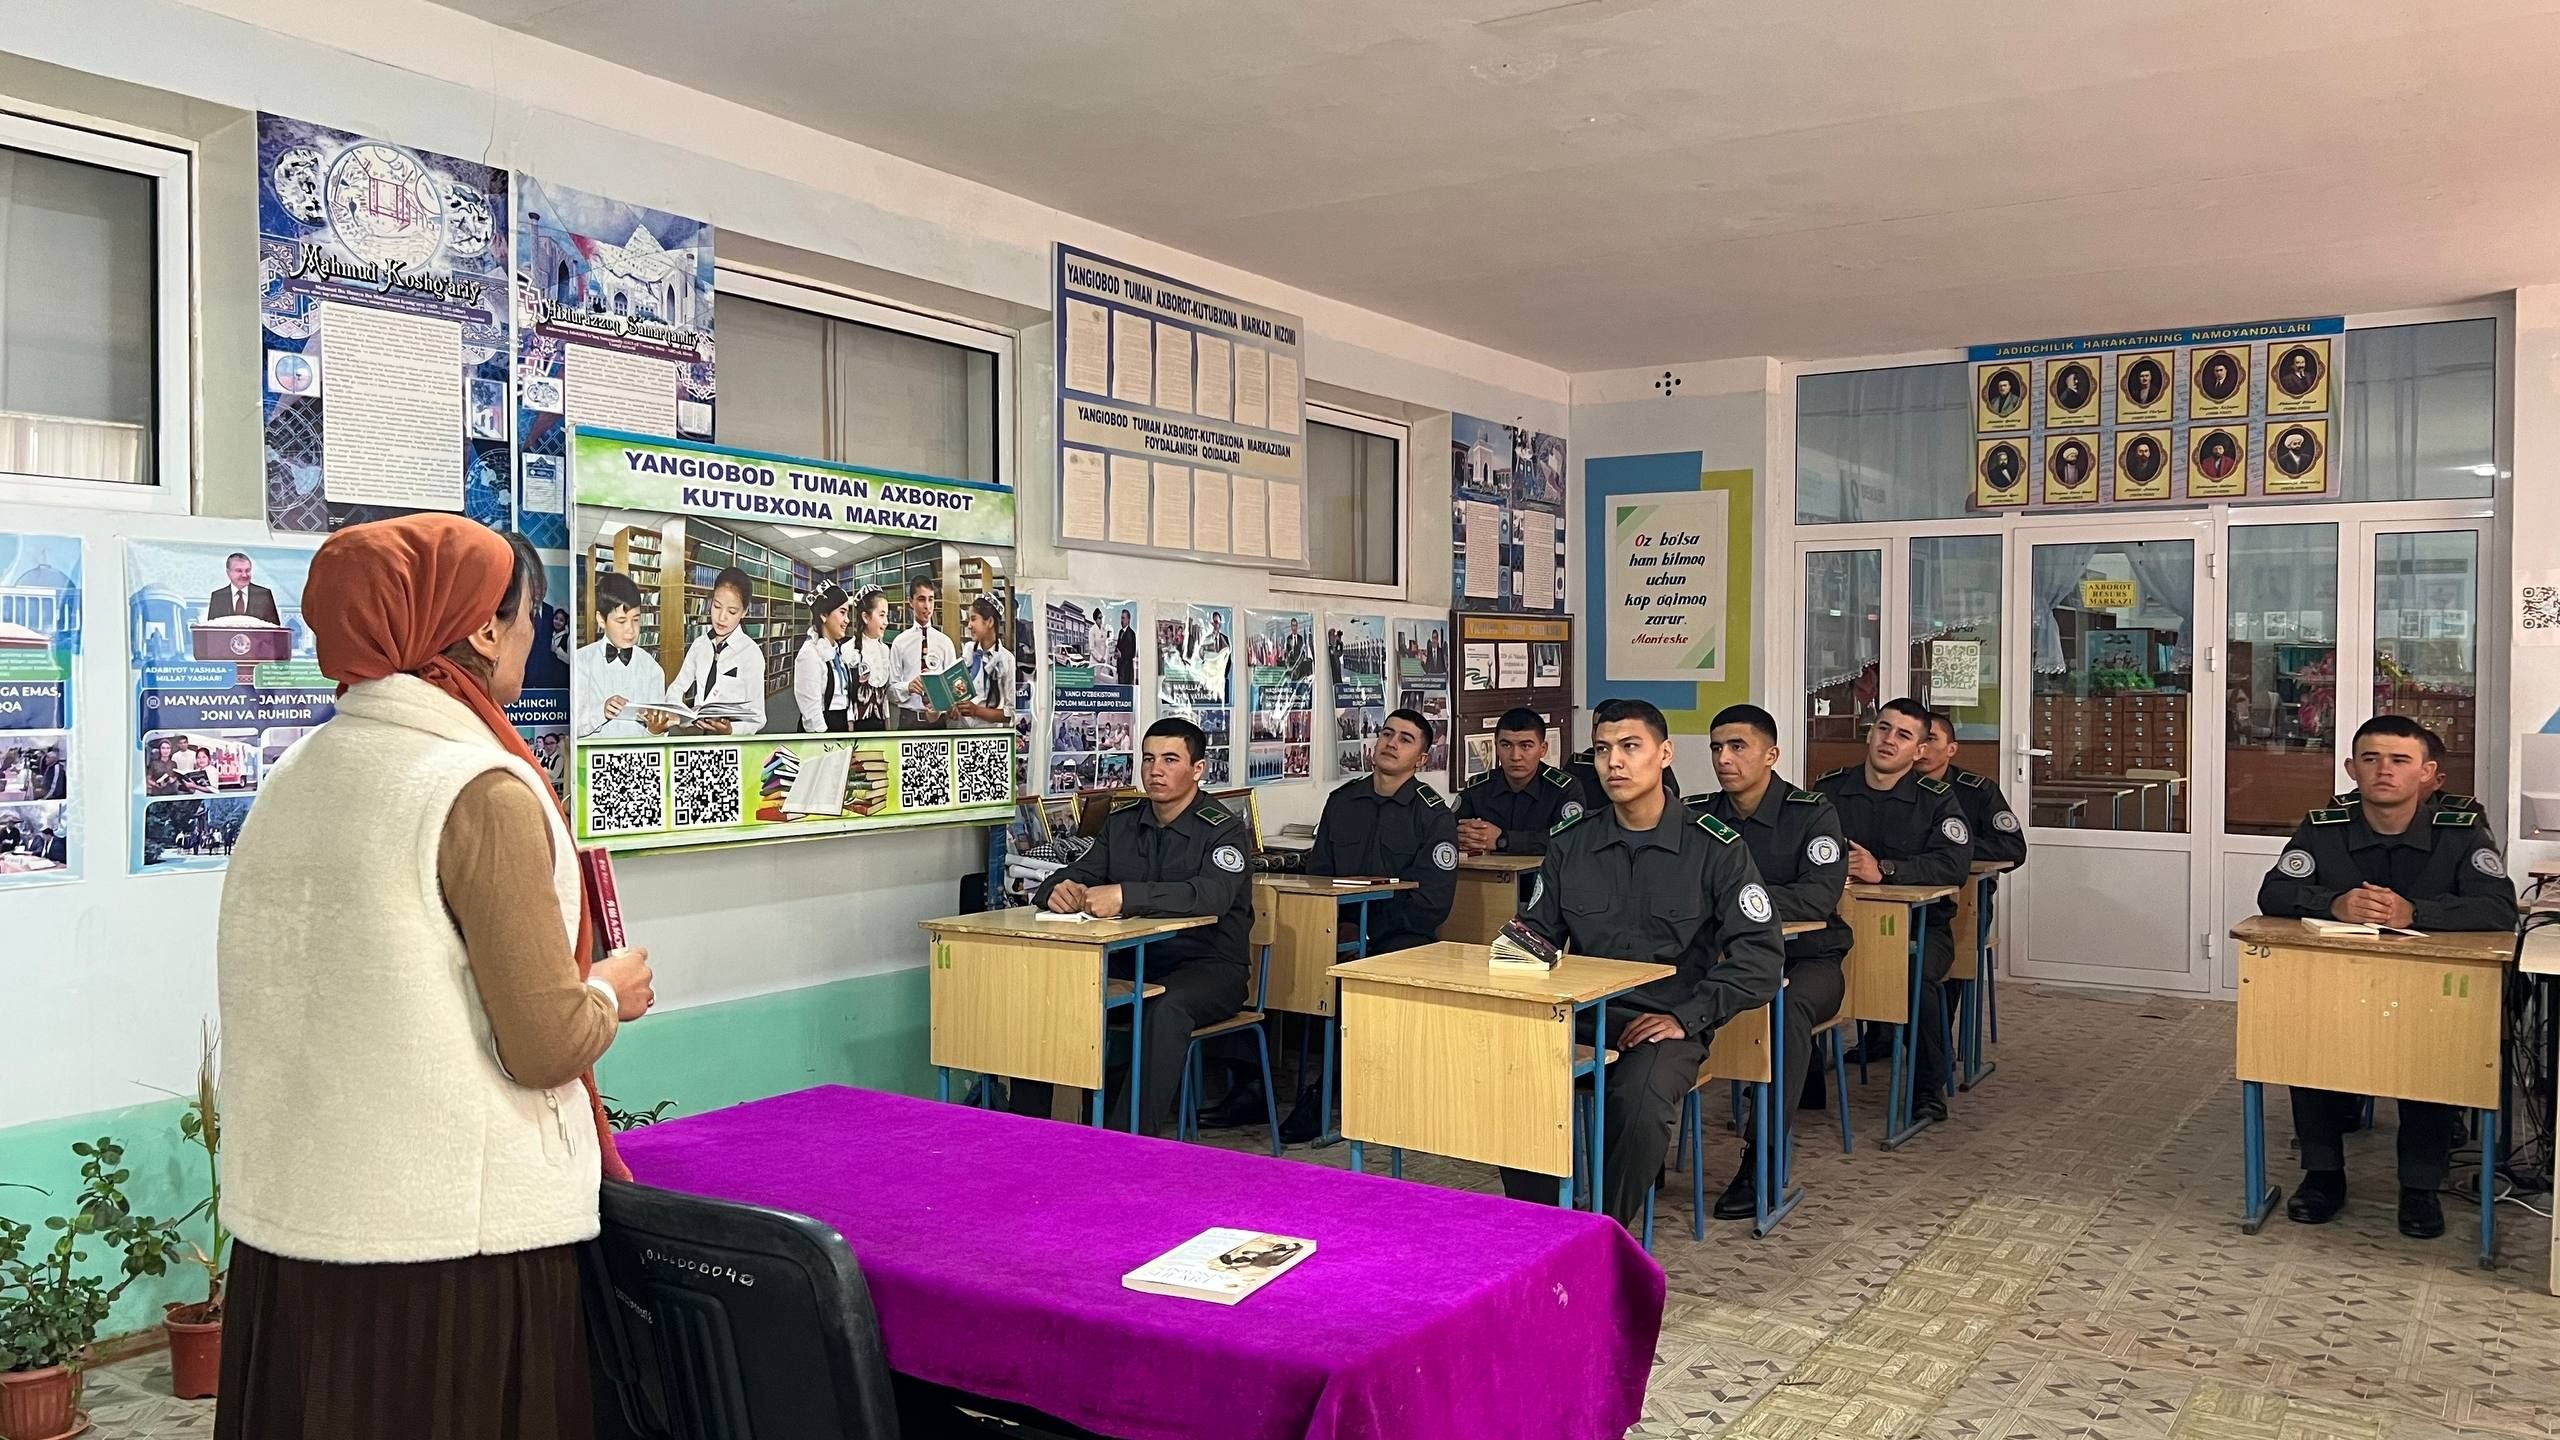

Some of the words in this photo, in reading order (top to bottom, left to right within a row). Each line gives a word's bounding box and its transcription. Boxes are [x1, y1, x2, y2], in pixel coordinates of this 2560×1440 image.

[289, 244, 378, 283] Mahmud
[377, 258, 481, 306] Koshg'ariy
[1067, 263, 1120, 295] YANGIOBOD
[1124, 280, 1152, 304] TUMAN
[1156, 289, 1238, 329] AXBOROT-KUTUBXONA
[1241, 315, 1271, 338] MARKAZI
[1274, 325, 1296, 346] NIZOMI
[1996, 342, 2074, 356] JADIDCHILIK
[2083, 330, 2182, 350] HARAKATINING
[2192, 323, 2311, 341] NAMOYANDALARI
[1078, 406, 1128, 428] YANGIOBOD
[1133, 417, 1161, 434] TUMAN
[1162, 424, 1244, 449] AXBOROT-KUTUBXONA
[1247, 439, 1291, 458] MARKAZIDAN
[1145, 438, 1198, 457] FOYDALANISH
[1202, 446, 1240, 464] QOIDALARI
[625, 451, 775, 487] YANGIOBOD
[789, 472, 868, 498] TUMAN
[880, 484, 973, 511] AXBOROT
[683, 488, 833, 520] KUTUBXONA
[846, 506, 938, 531] MARKAZI
[1629, 553, 1657, 566] ham
[1661, 552, 1705, 566] bilmoq
[1646, 571, 1686, 586] uchun
[1631, 633, 1689, 645] Monteske
[22, 686, 62, 698] EMAS,
[164, 694, 246, 706] MA'NAVIYAT
[259, 693, 337, 706] JAMIYATNIN
[200, 710, 233, 721] JONI
[236, 710, 255, 721] VA
[258, 709, 312, 720] RUHIDIR
